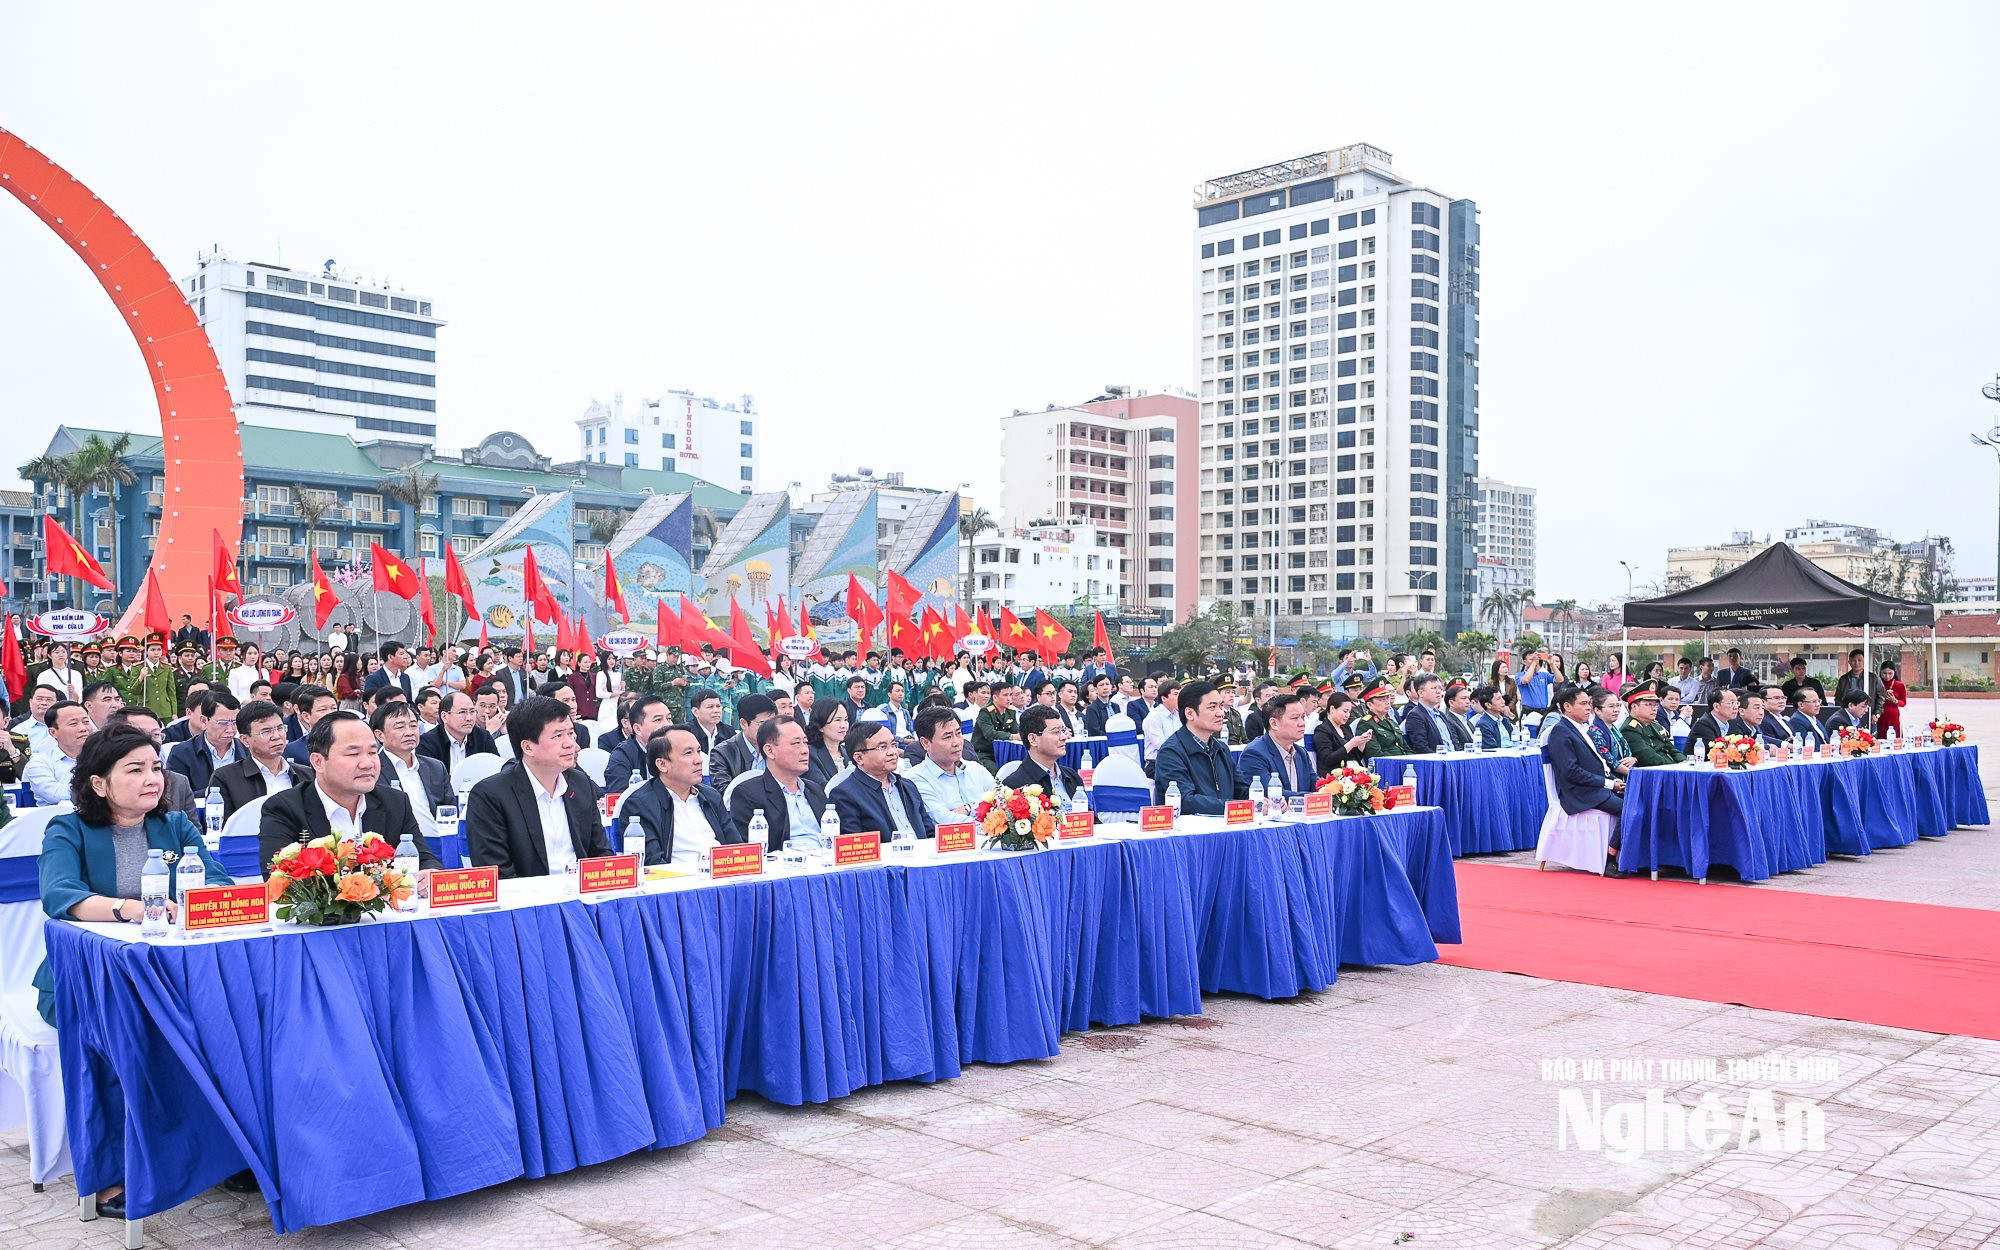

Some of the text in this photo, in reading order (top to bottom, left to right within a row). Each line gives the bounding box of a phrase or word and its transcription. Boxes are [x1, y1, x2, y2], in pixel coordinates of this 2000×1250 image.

[679, 451, 699, 460] HOTEL
[616, 868, 633, 877] QUANG
[436, 878, 490, 892] HOÀNG QUỐC VIỆT
[190, 897, 264, 912] NGUYỄN THỊ HỒNG HOA
